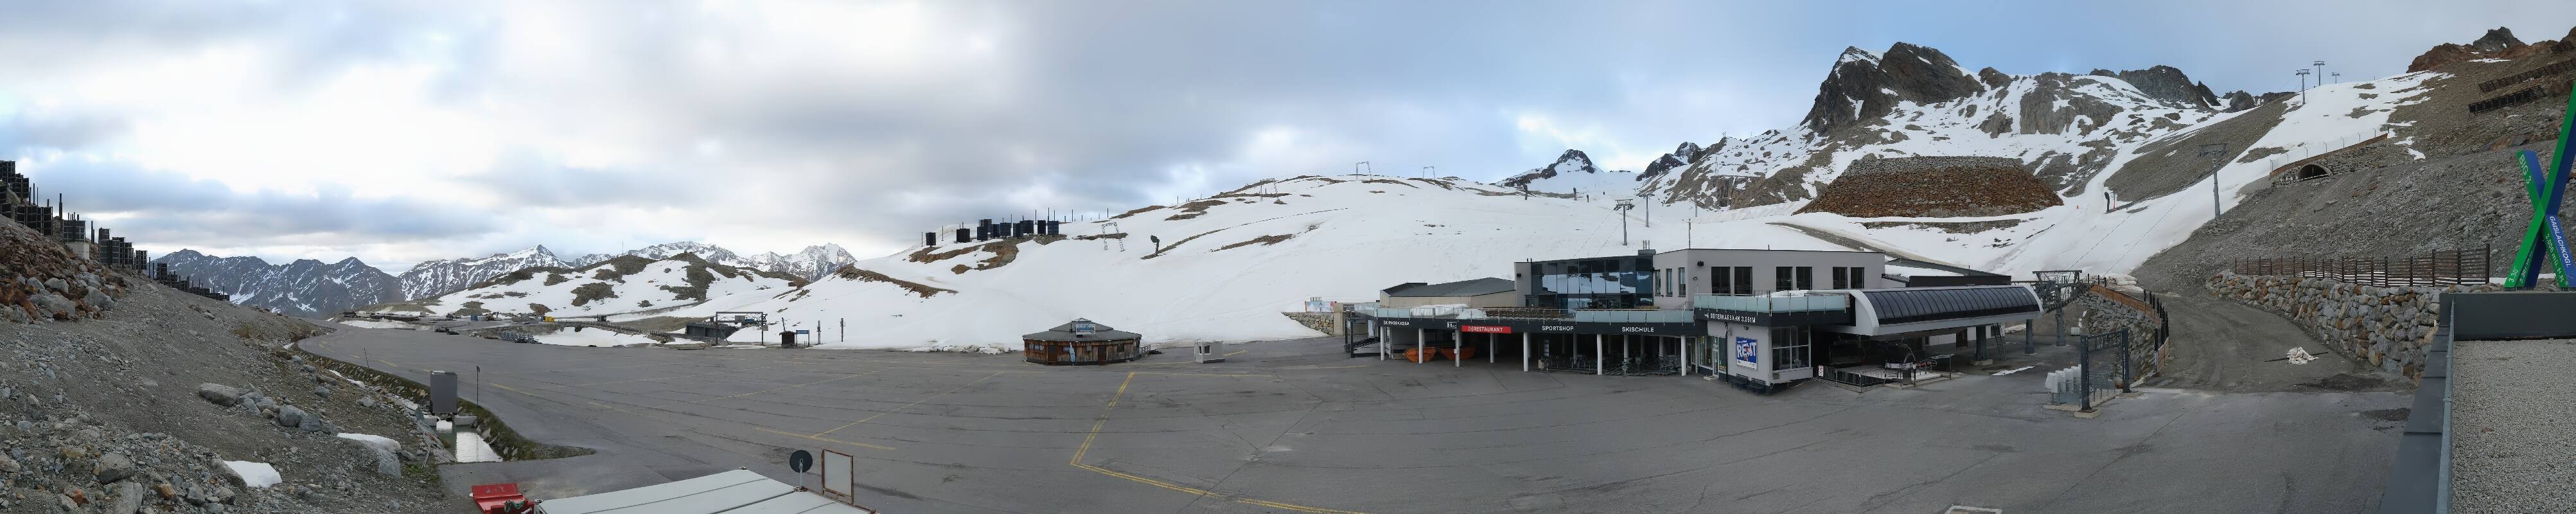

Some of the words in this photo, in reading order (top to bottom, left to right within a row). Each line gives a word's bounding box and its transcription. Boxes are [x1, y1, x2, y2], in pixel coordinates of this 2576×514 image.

[2519, 154, 2528, 175] BIG
[2526, 175, 2532, 184] 3
[2550, 216, 2572, 267] GAISLACHKOGL
[2509, 267, 2519, 283] 3.30
